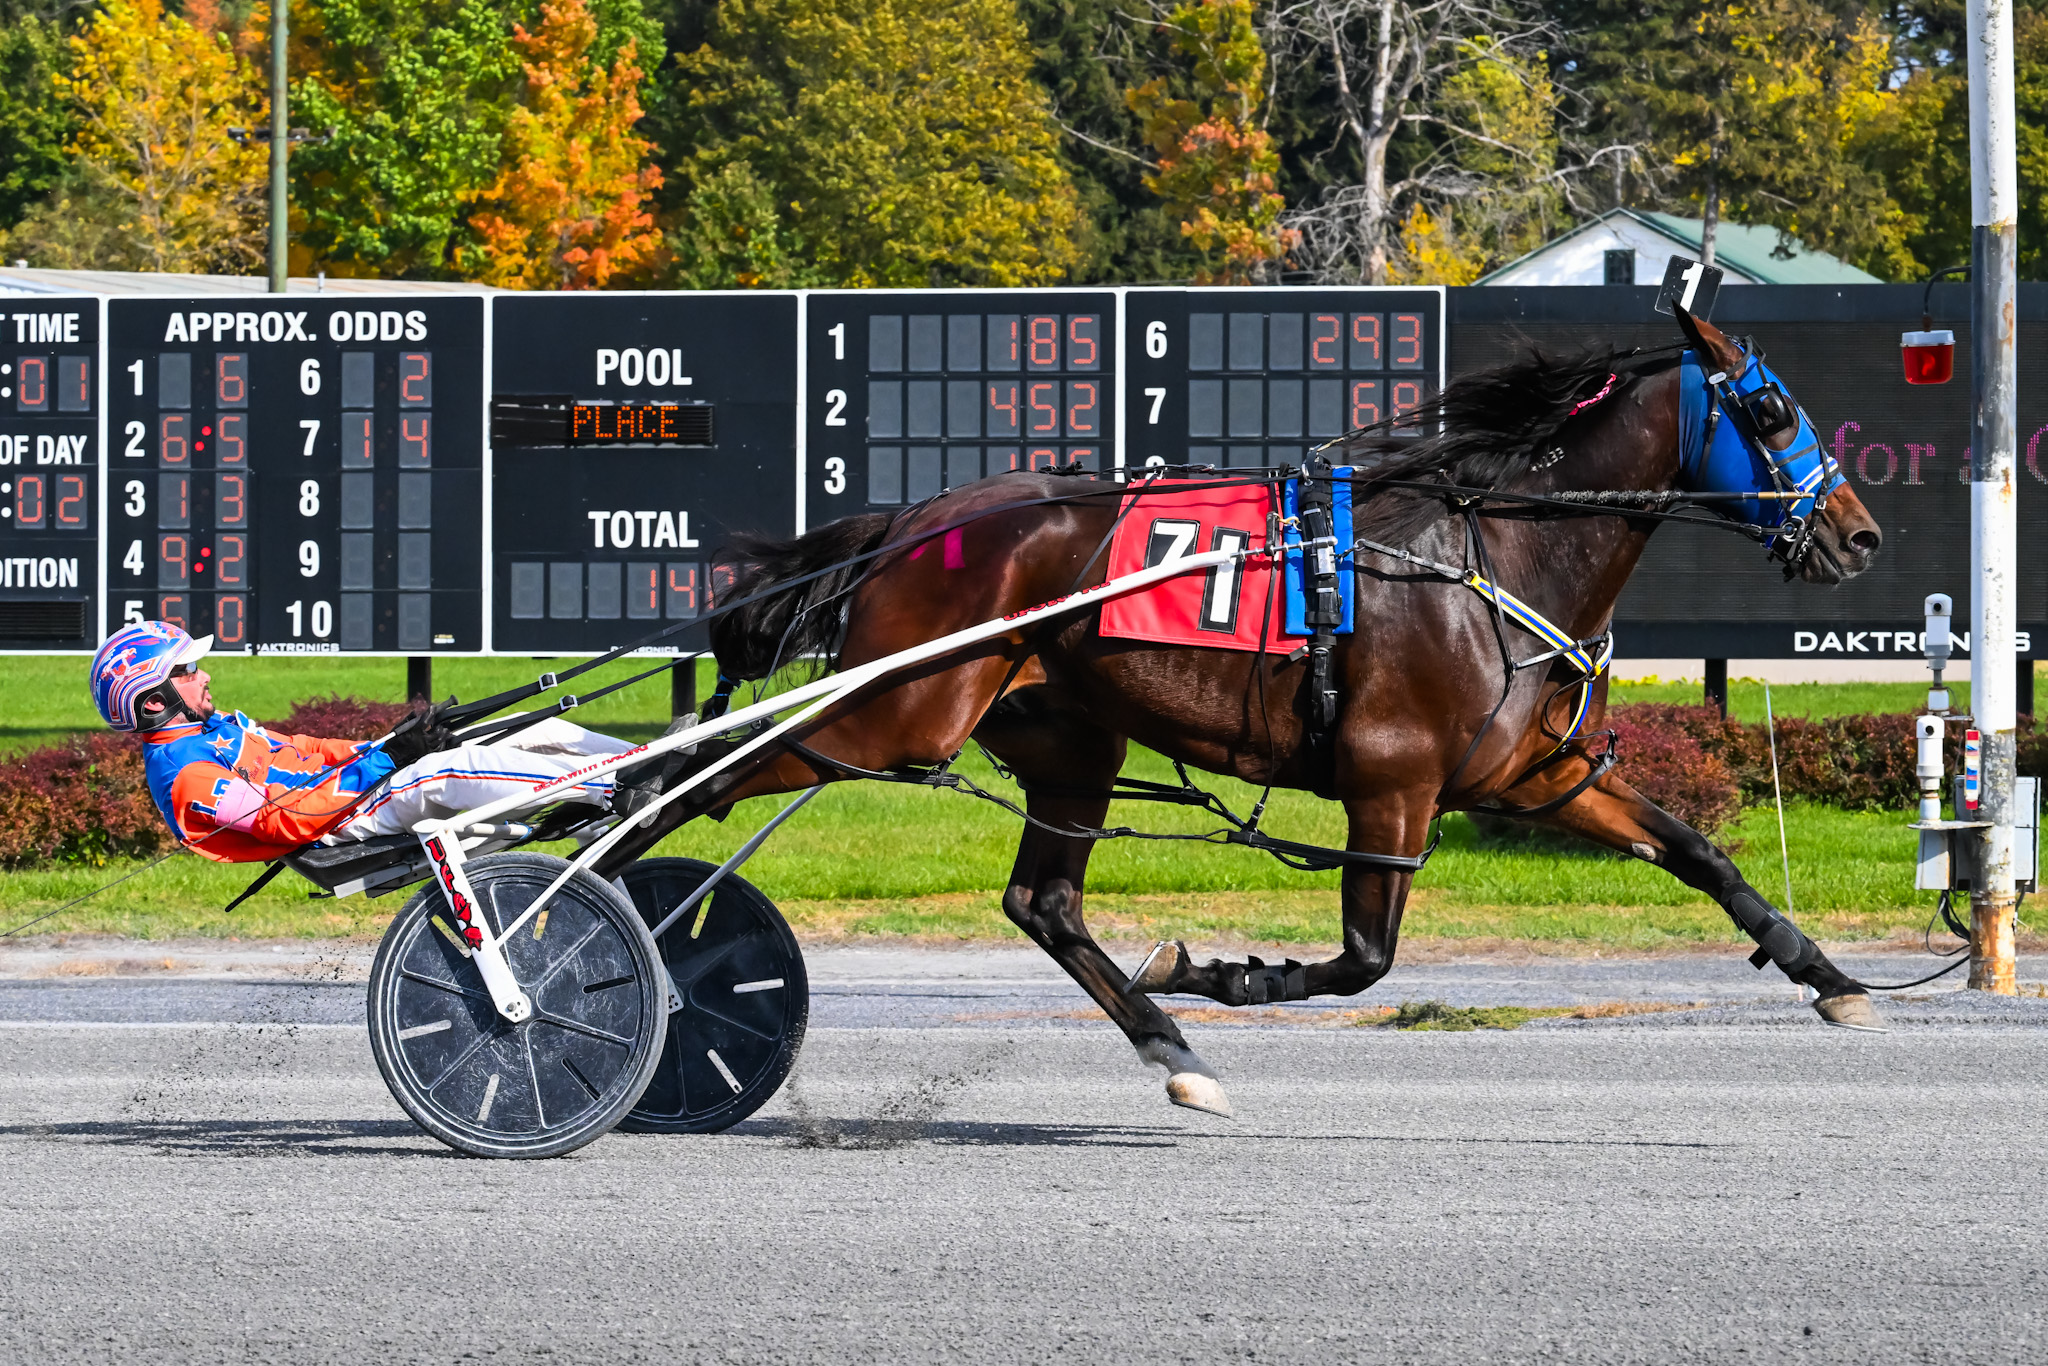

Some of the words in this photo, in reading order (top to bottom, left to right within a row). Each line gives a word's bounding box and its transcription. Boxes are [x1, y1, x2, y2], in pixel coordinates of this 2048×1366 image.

[1680, 262, 1705, 313] 1
[12, 313, 79, 343] TIME
[164, 312, 316, 343] APPROX.
[329, 311, 427, 342] ODDS
[828, 323, 845, 360] 1
[1009, 316, 1096, 365] 185
[1145, 320, 1167, 358] 6
[1313, 316, 1421, 364] 293
[127, 359, 145, 395] 1
[218, 356, 245, 401] 6
[300, 359, 321, 395] 6
[402, 355, 427, 400] 2
[597, 348, 692, 386] POOL
[573, 406, 679, 438] PLACE
[824, 389, 847, 426] 2
[990, 383, 1096, 431] 452
[1145, 387, 1166, 424] 7
[0, 434, 29, 465] OF
[37, 434, 88, 465] DAY
[124, 420, 146, 457] 2
[299, 420, 321, 456] 7
[364, 419, 427, 458] 14
[1829, 421, 1936, 485] for
[824, 457, 846, 494] 3
[124, 480, 146, 517] 3
[180, 476, 244, 522] 13
[299, 480, 320, 517] 8
[588, 511, 699, 548] TOTAL
[0, 557, 78, 588] ITION
[123, 540, 144, 575] 4
[299, 540, 321, 577] 9
[124, 601, 144, 628] 5
[286, 600, 332, 637] 10
[1794, 632, 2030, 652] DAKTRNS
